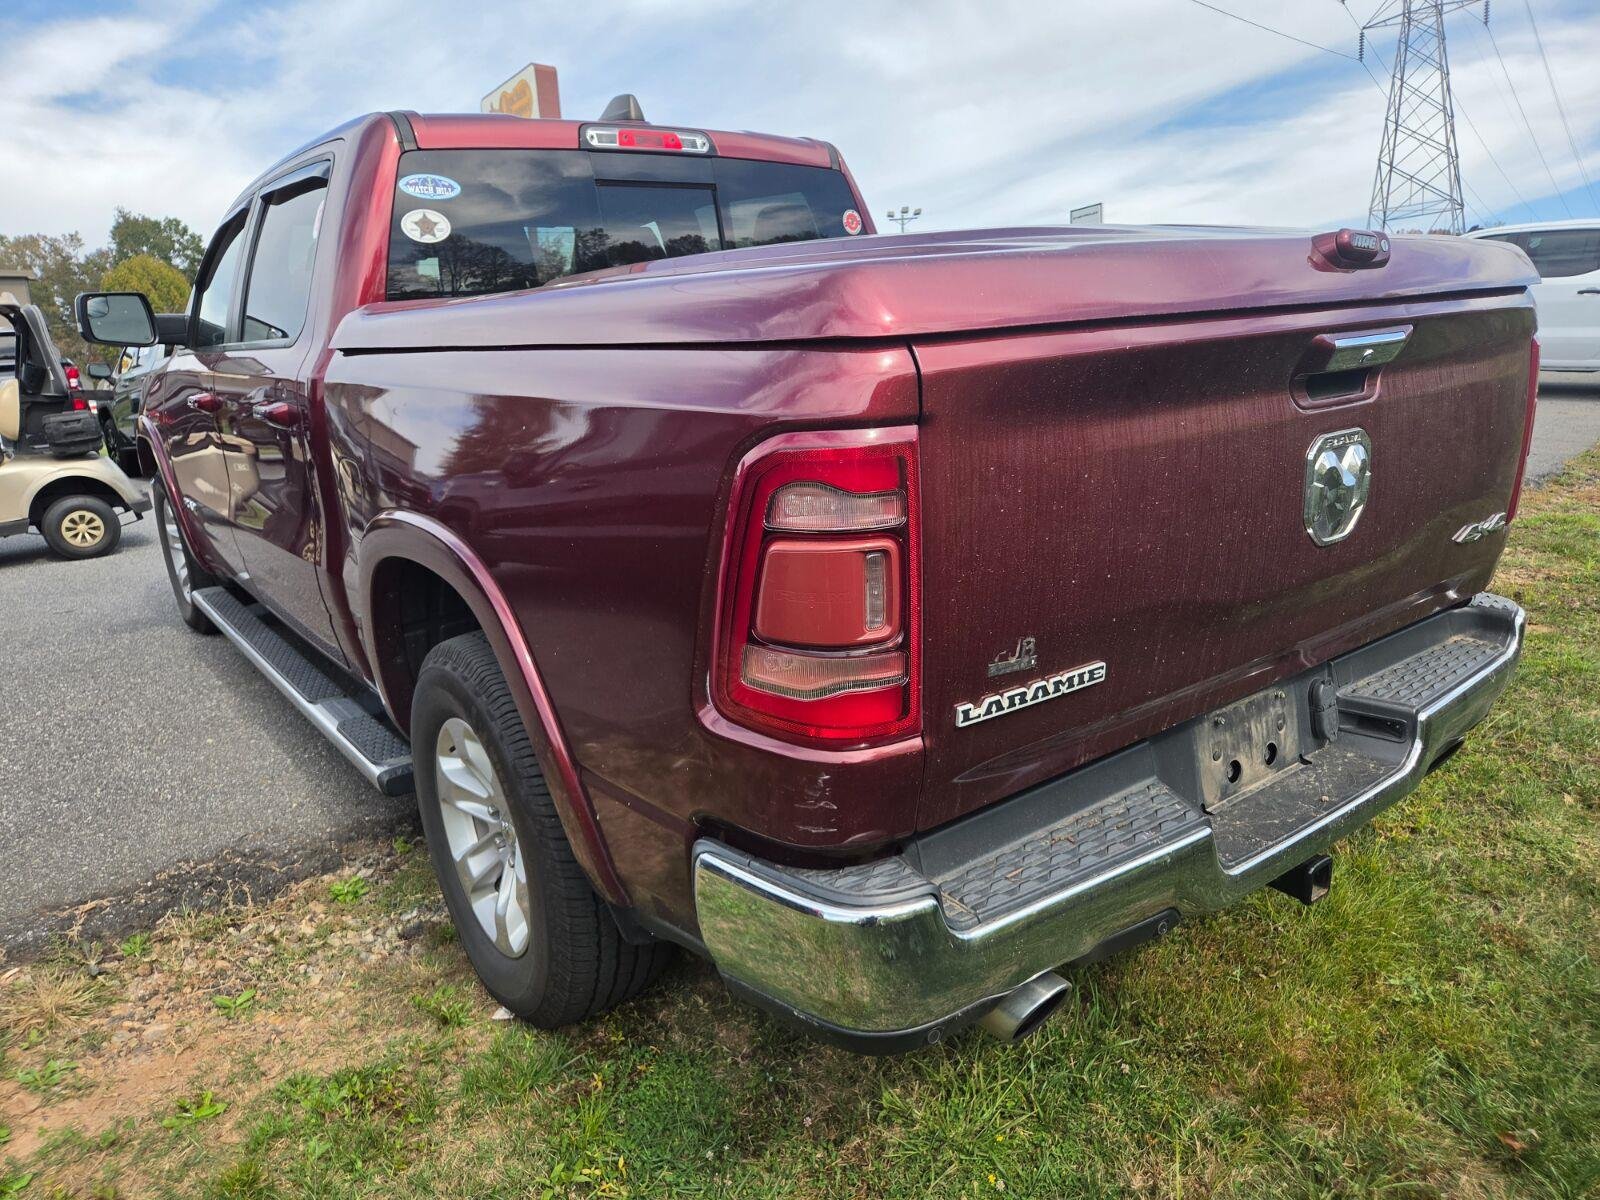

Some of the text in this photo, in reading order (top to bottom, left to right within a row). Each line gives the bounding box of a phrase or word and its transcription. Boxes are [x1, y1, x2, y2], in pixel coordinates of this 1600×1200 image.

[407, 185, 454, 195] WATCH HILL
[956, 661, 1106, 727] LARAMIE
